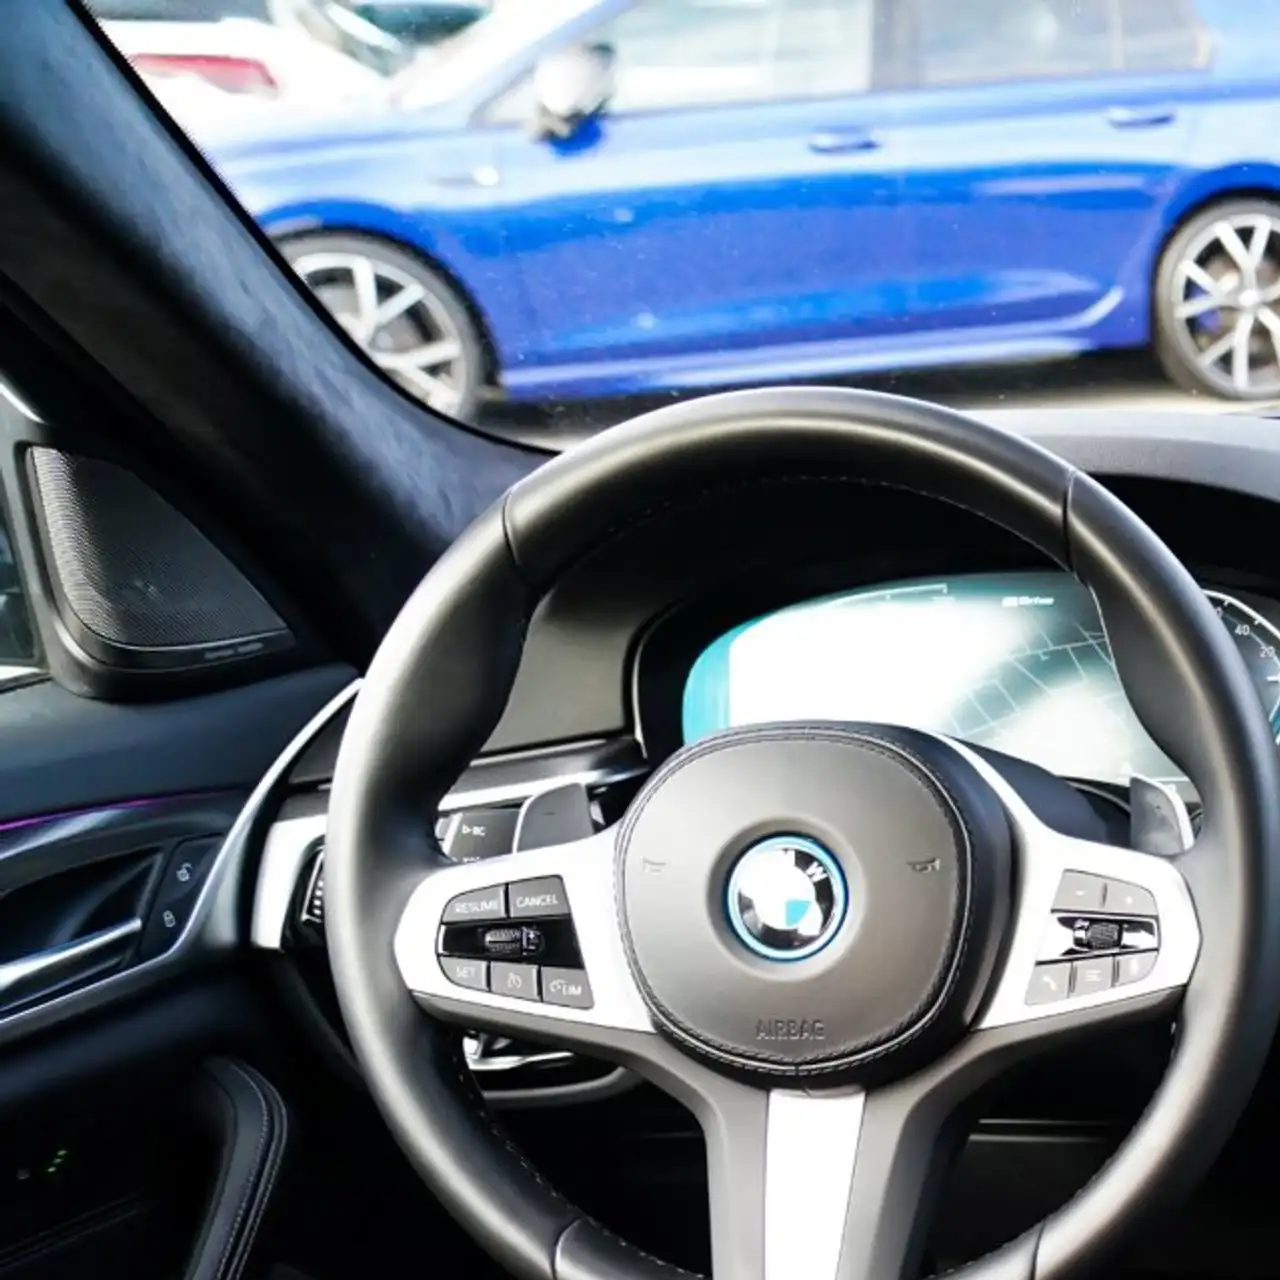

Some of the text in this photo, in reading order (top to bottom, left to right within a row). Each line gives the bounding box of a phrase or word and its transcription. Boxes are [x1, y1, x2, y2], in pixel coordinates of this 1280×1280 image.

[1234, 624, 1250, 636] 40
[1260, 645, 1276, 658] 20
[455, 899, 500, 914] RESUME
[516, 894, 558, 908] CANCEL
[456, 965, 477, 978] SET
[562, 983, 582, 996] LIM
[755, 1019, 826, 1040] AIRBAG
